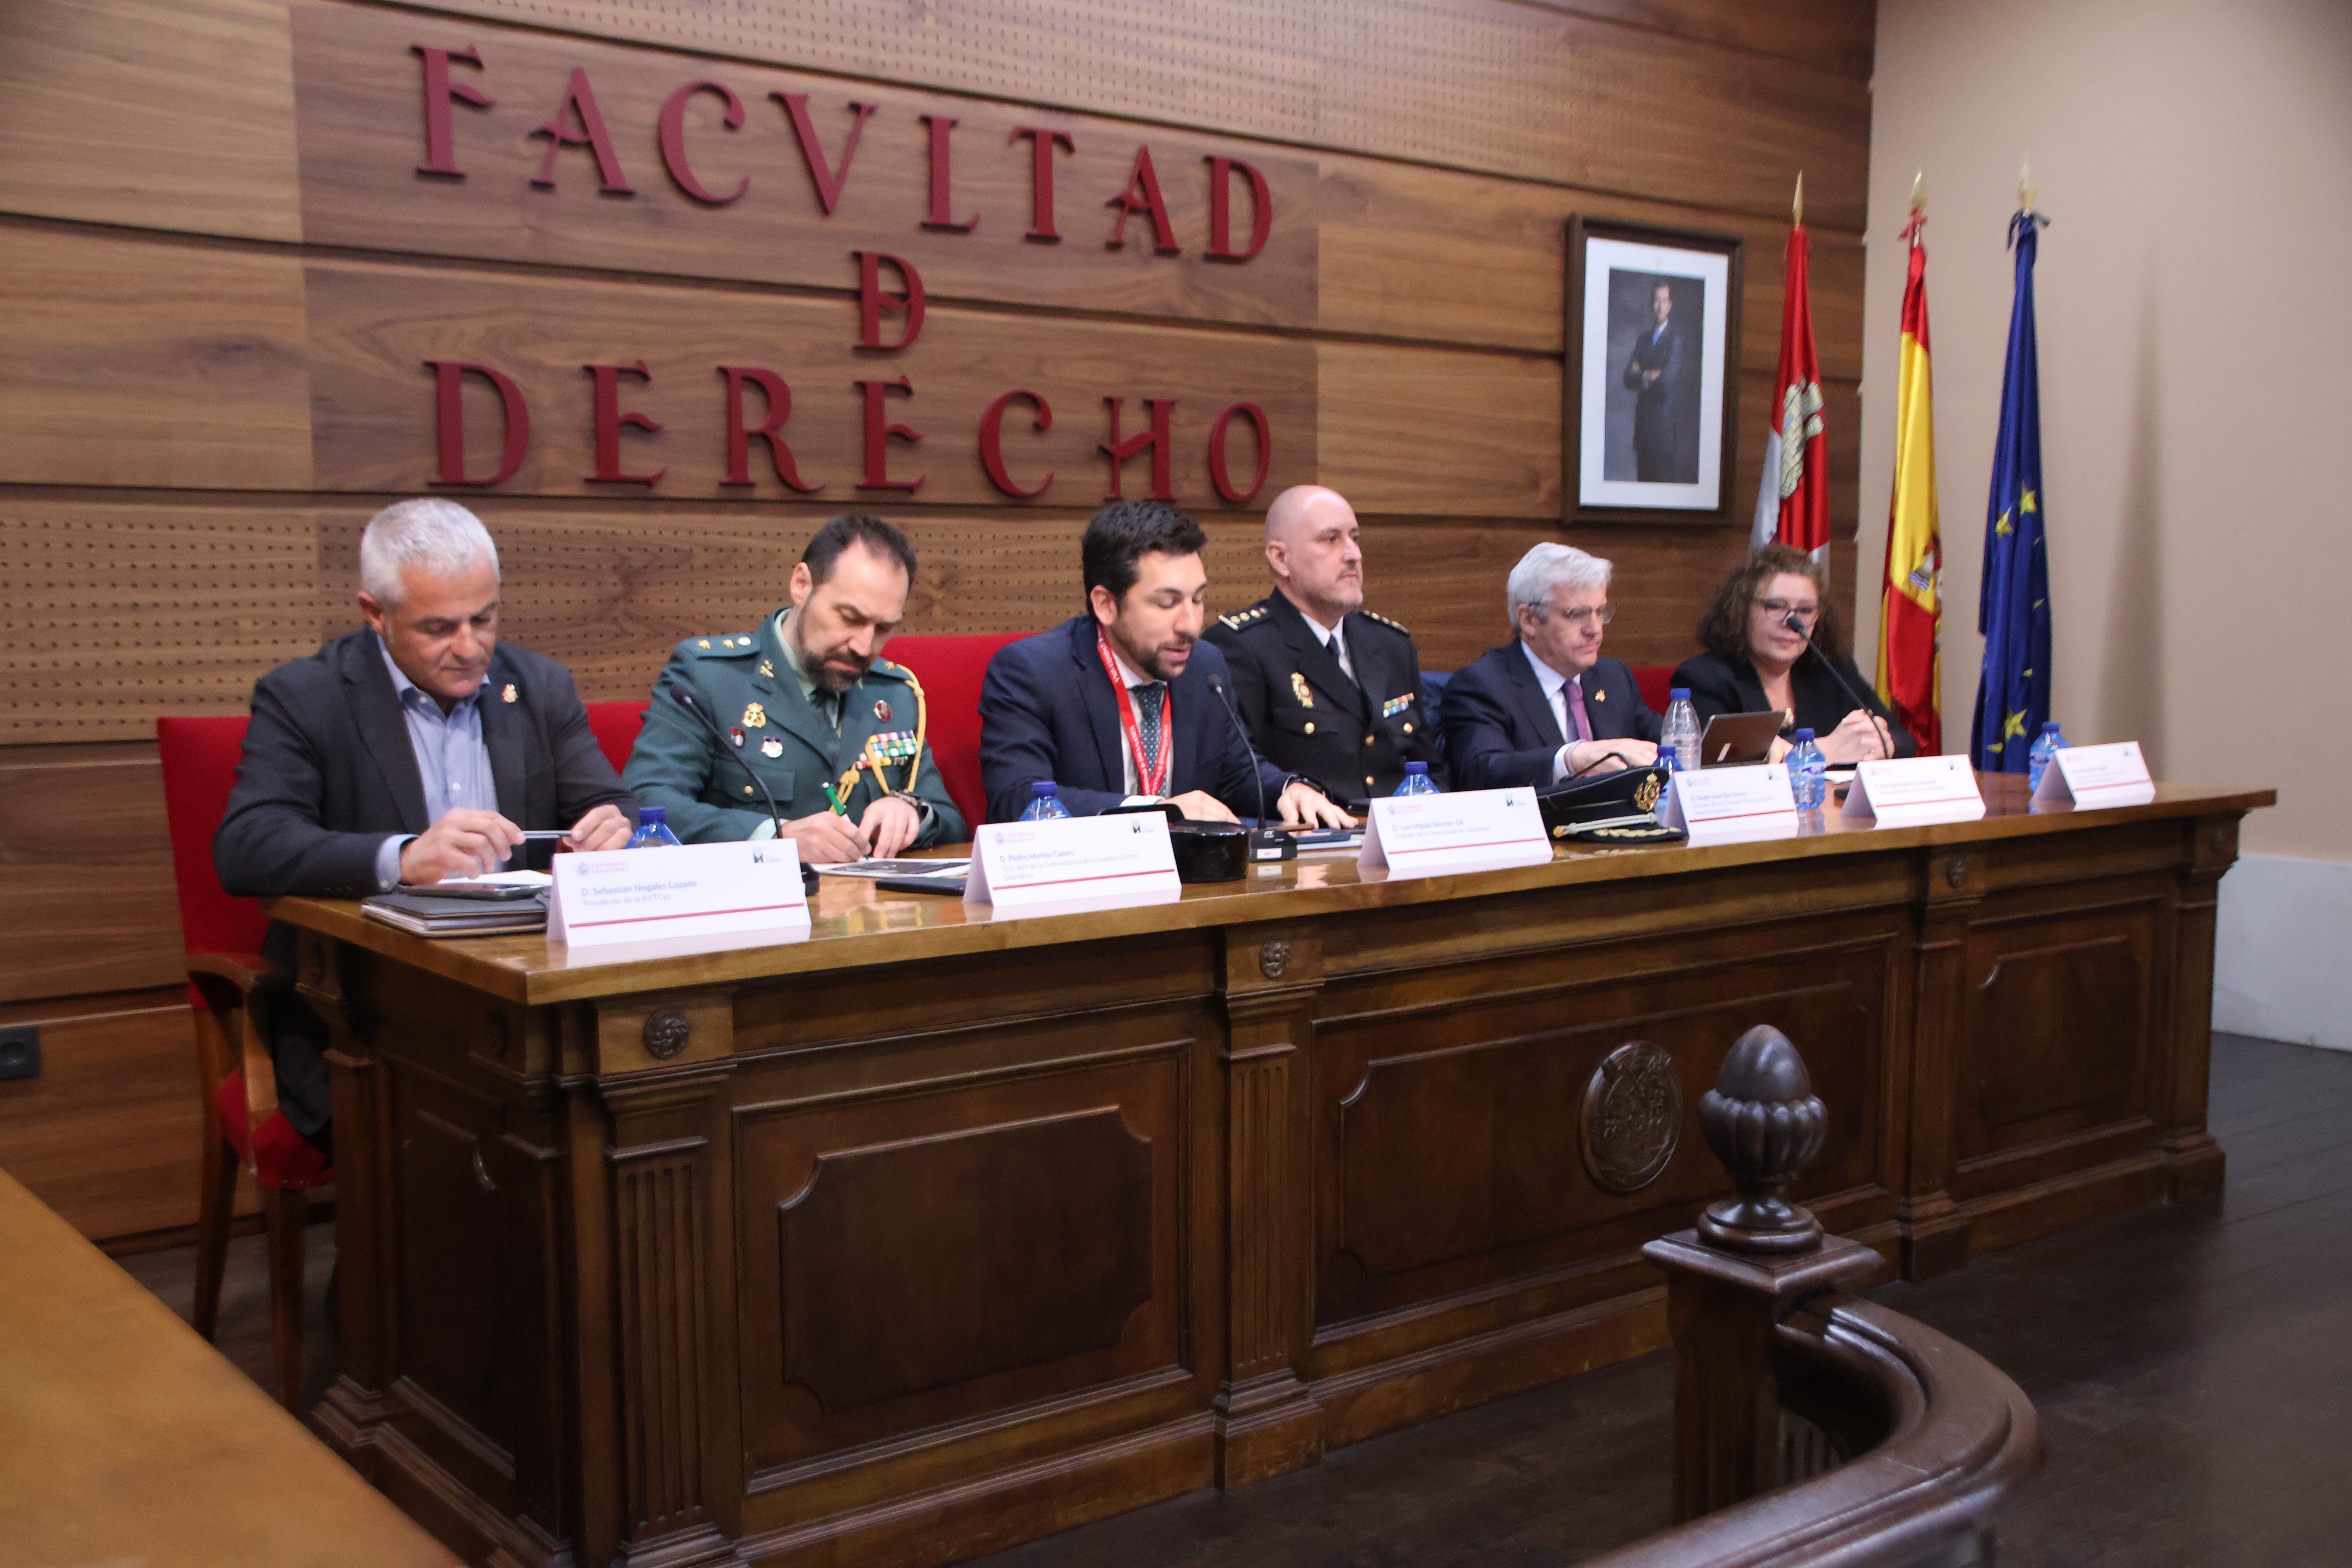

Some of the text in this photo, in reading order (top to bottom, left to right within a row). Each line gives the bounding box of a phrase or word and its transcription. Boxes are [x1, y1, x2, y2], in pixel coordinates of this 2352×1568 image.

[413, 45, 1273, 261] FACVLTAD
[426, 359, 1271, 502] DERECHO
[1009, 853, 1028, 862] Pedro
[1029, 851, 1052, 860] Merino
[582, 880, 697, 896] D. Sebastián Nogales Lozano
[583, 897, 622, 907] Presidente
